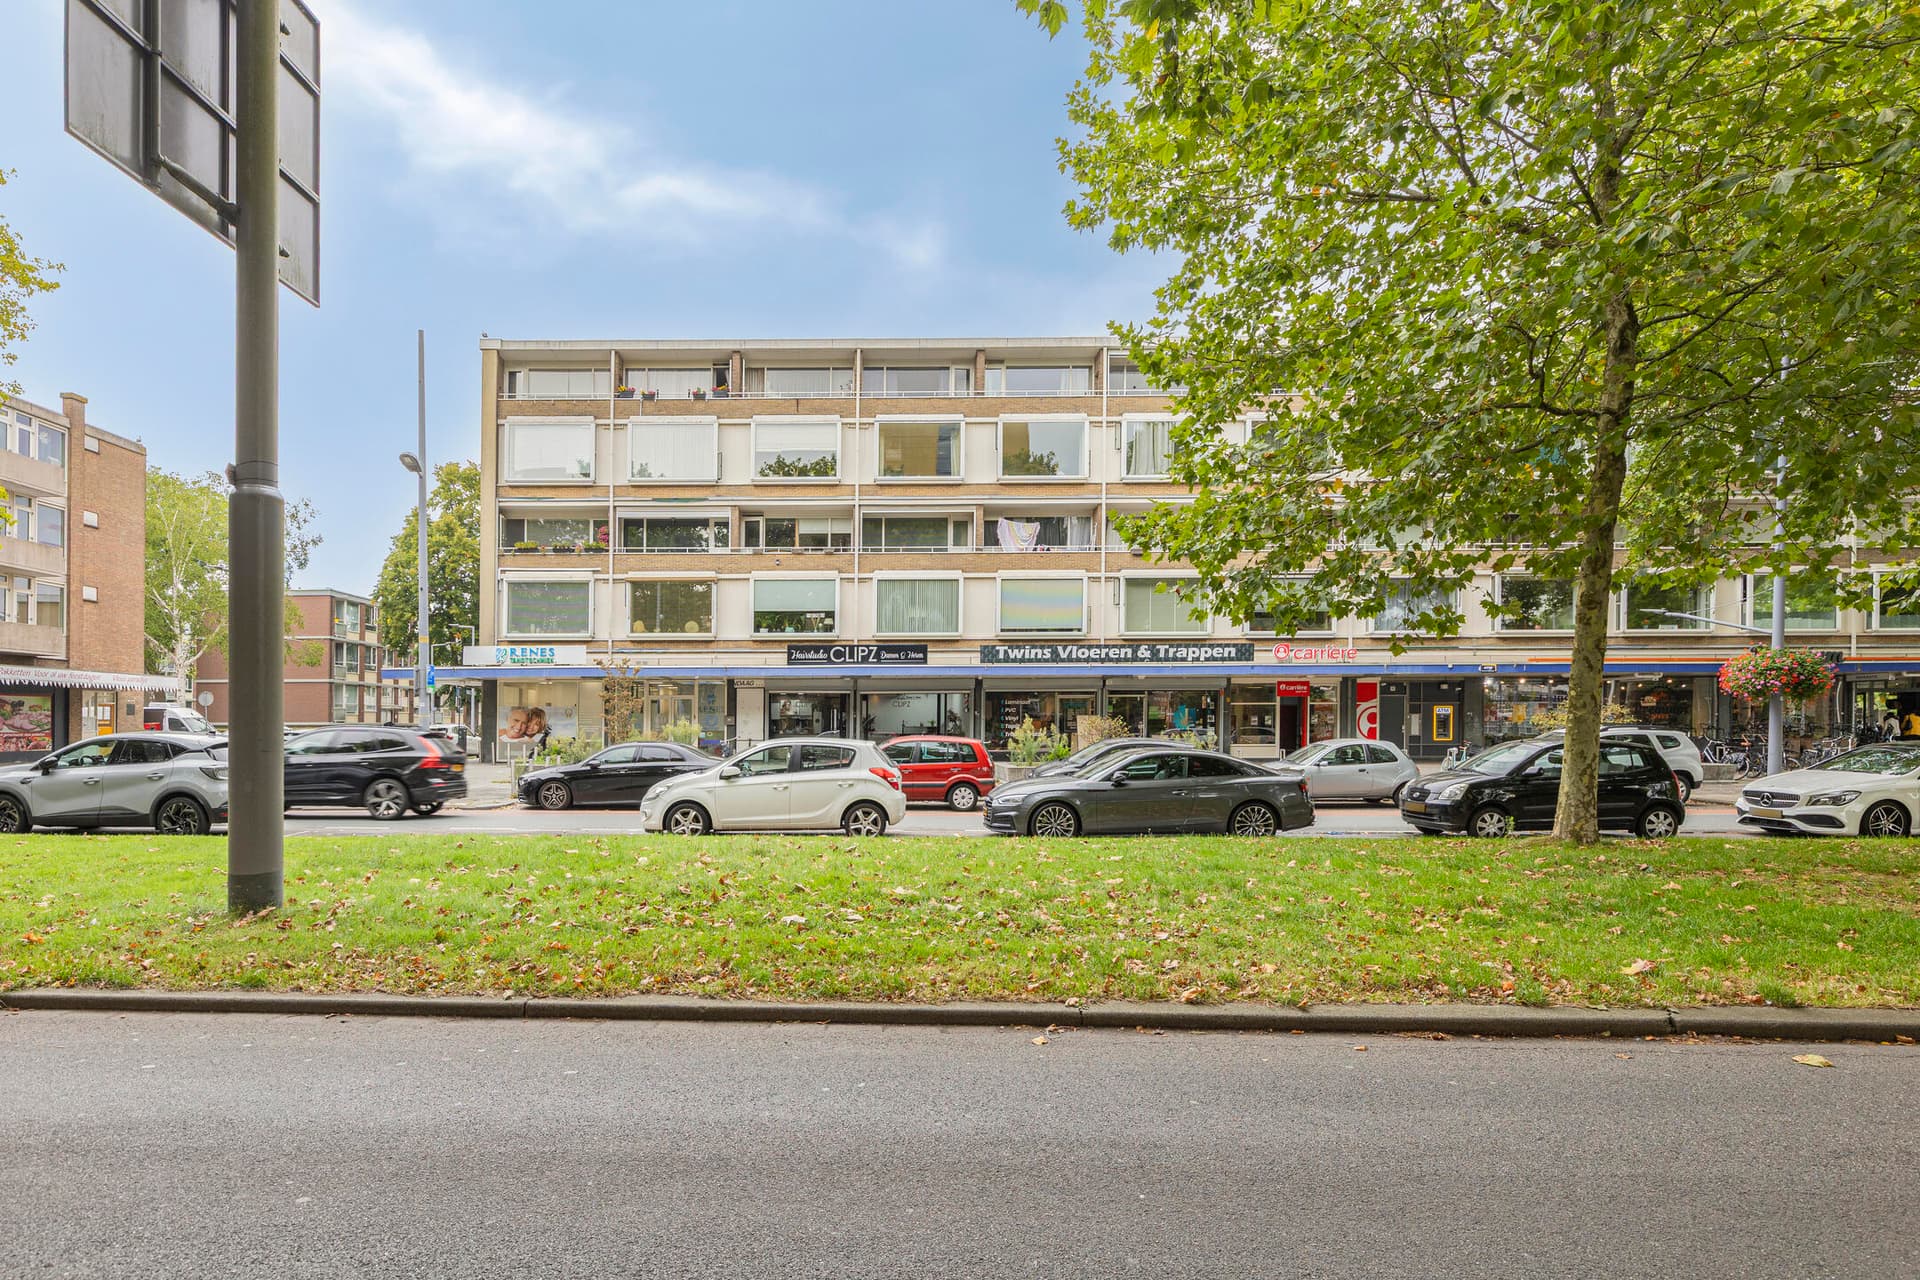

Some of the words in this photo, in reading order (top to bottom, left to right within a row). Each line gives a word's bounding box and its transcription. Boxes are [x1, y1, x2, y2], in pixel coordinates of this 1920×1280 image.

[509, 647, 555, 657] RENES
[790, 649, 828, 659] Hairstudio
[830, 646, 878, 662] CLIPZ
[995, 646, 1051, 659] Twins
[1056, 645, 1132, 659] Vloeren
[1136, 645, 1151, 658] &
[1156, 644, 1236, 661] Trappen
[1293, 644, 1358, 660] carrière
